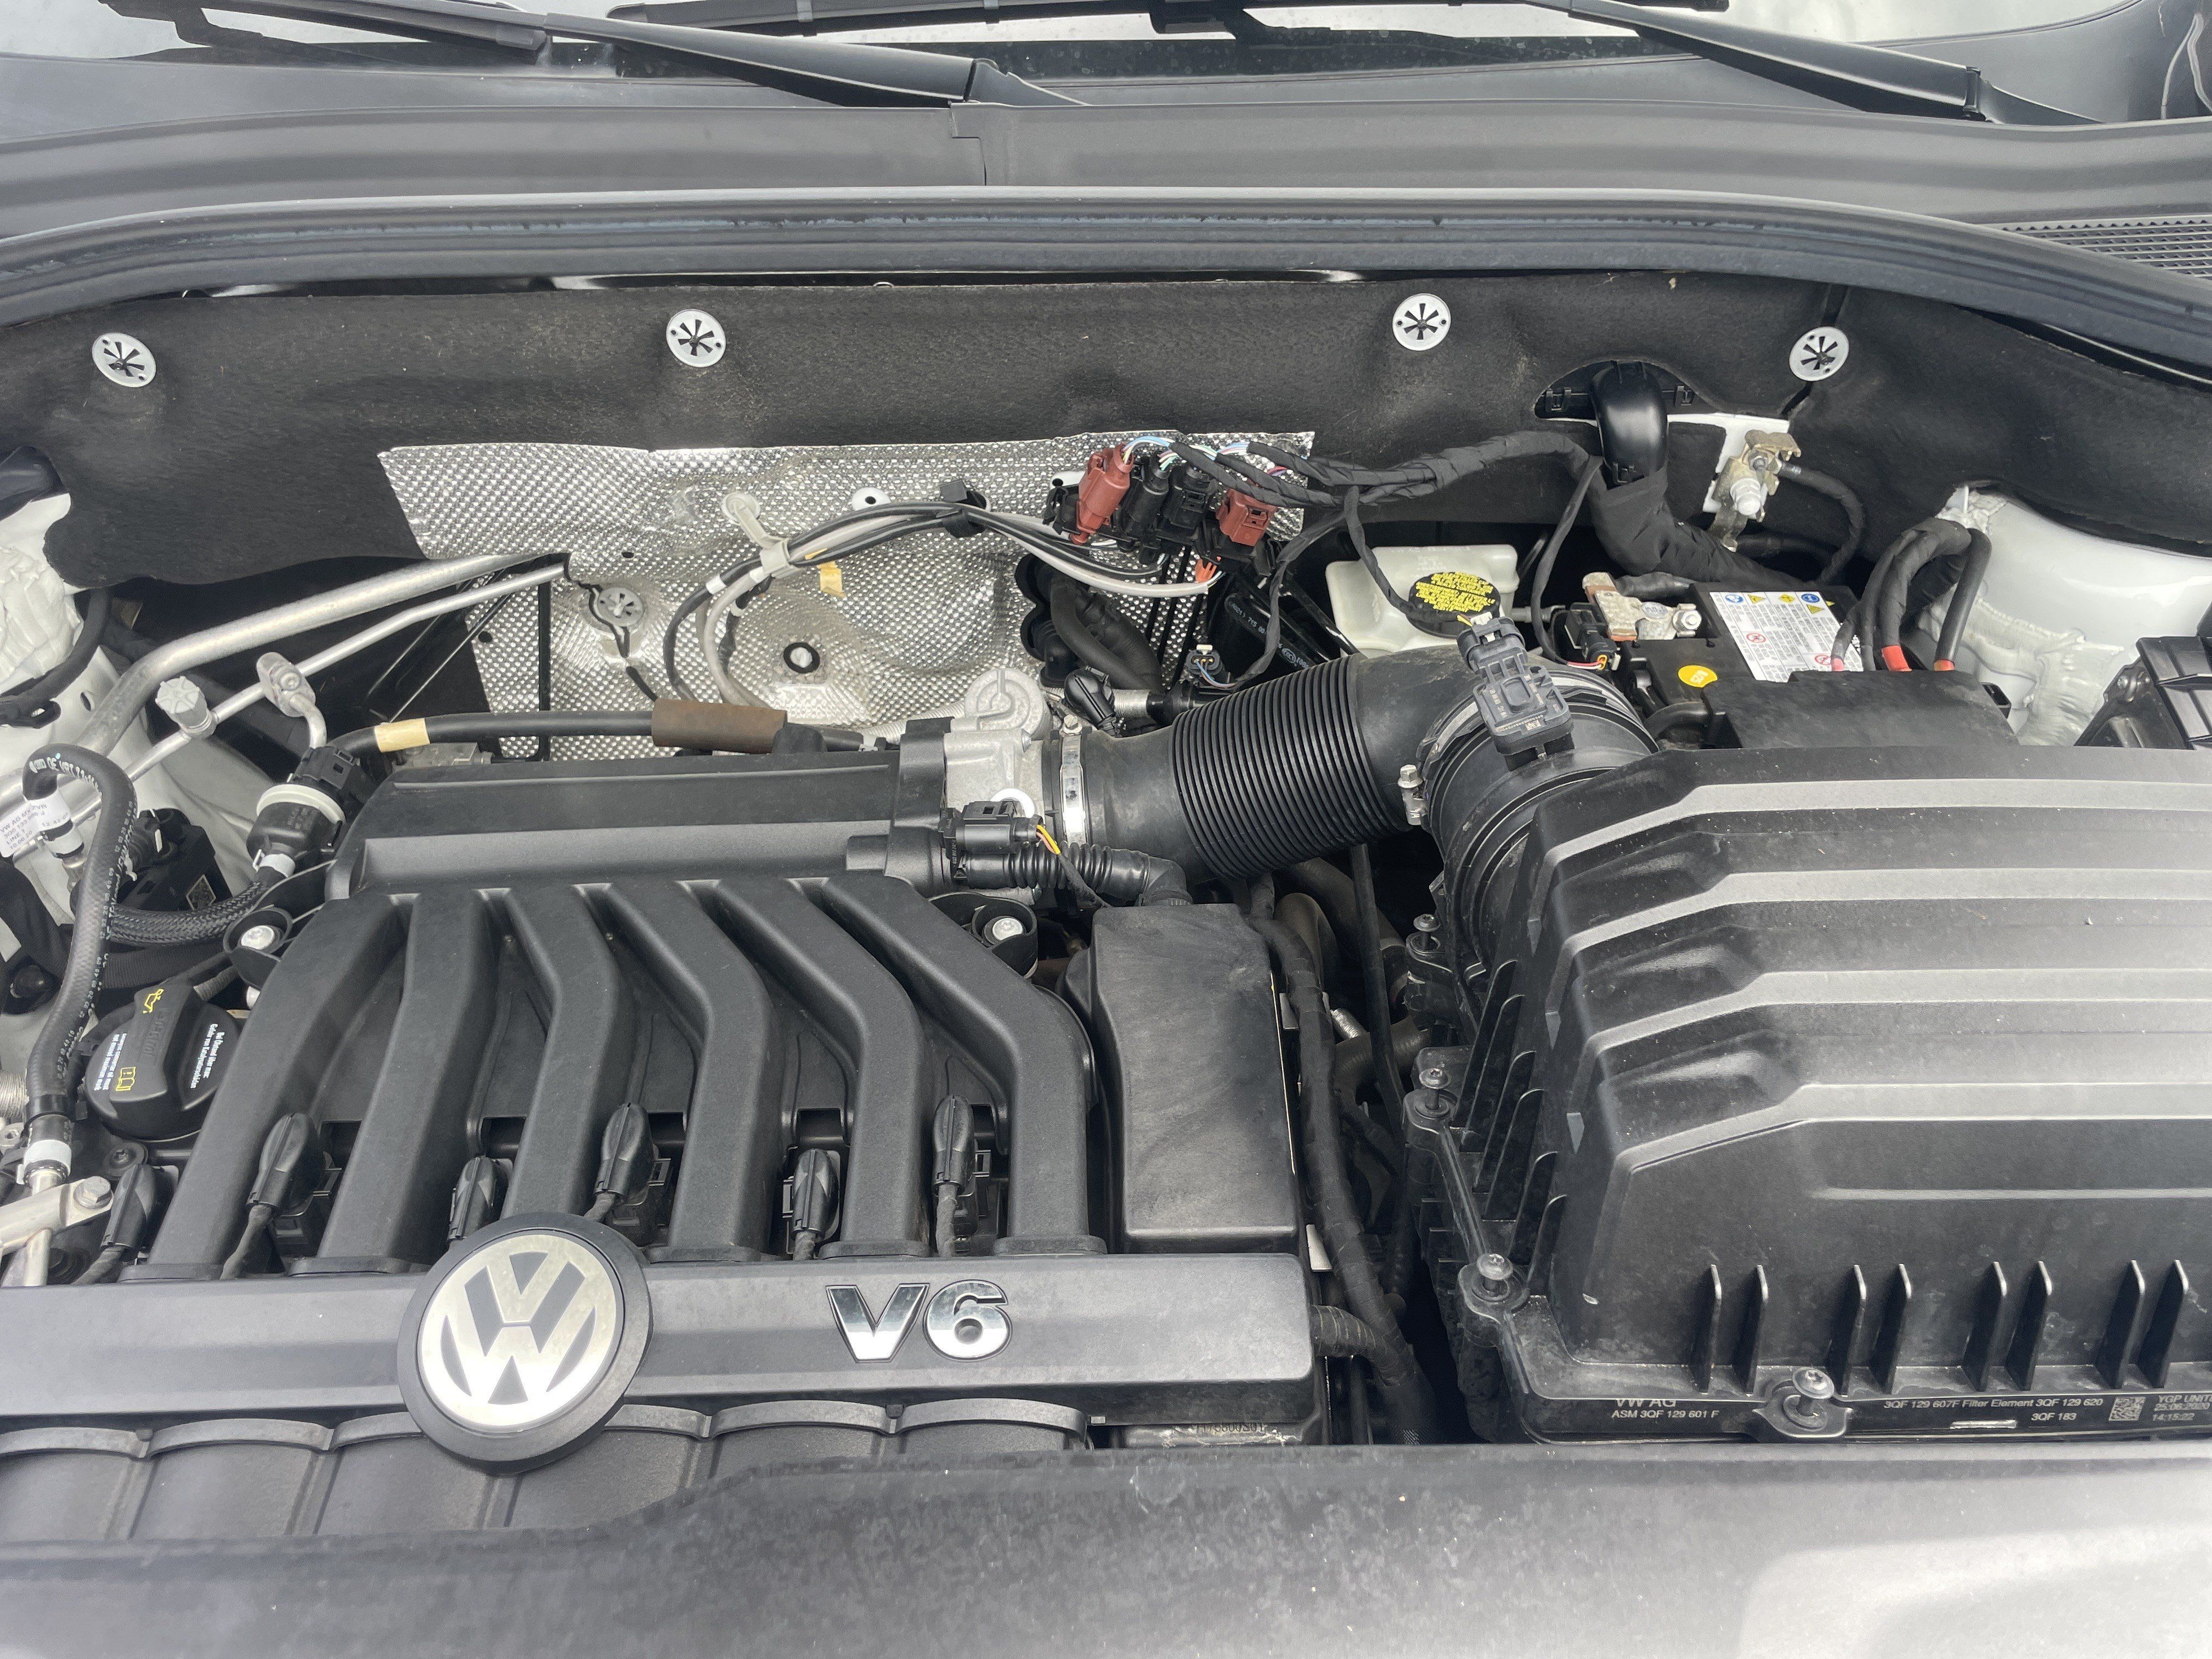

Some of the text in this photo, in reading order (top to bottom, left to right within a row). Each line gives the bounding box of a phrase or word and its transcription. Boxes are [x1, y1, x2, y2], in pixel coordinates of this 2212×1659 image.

[825, 1279, 1013, 1364] V6
[1616, 1399, 1677, 1407] VW AG
[1884, 1400, 1908, 1409] 3QF
[1911, 1400, 1931, 1408] 129
[1990, 1399, 2034, 1407] Element
[2035, 1398, 2060, 1407] 3QF
[1611, 1410, 1638, 1419] ASM
[1640, 1410, 1664, 1418] 3QF
[2031, 1413, 2055, 1421] 3QF
